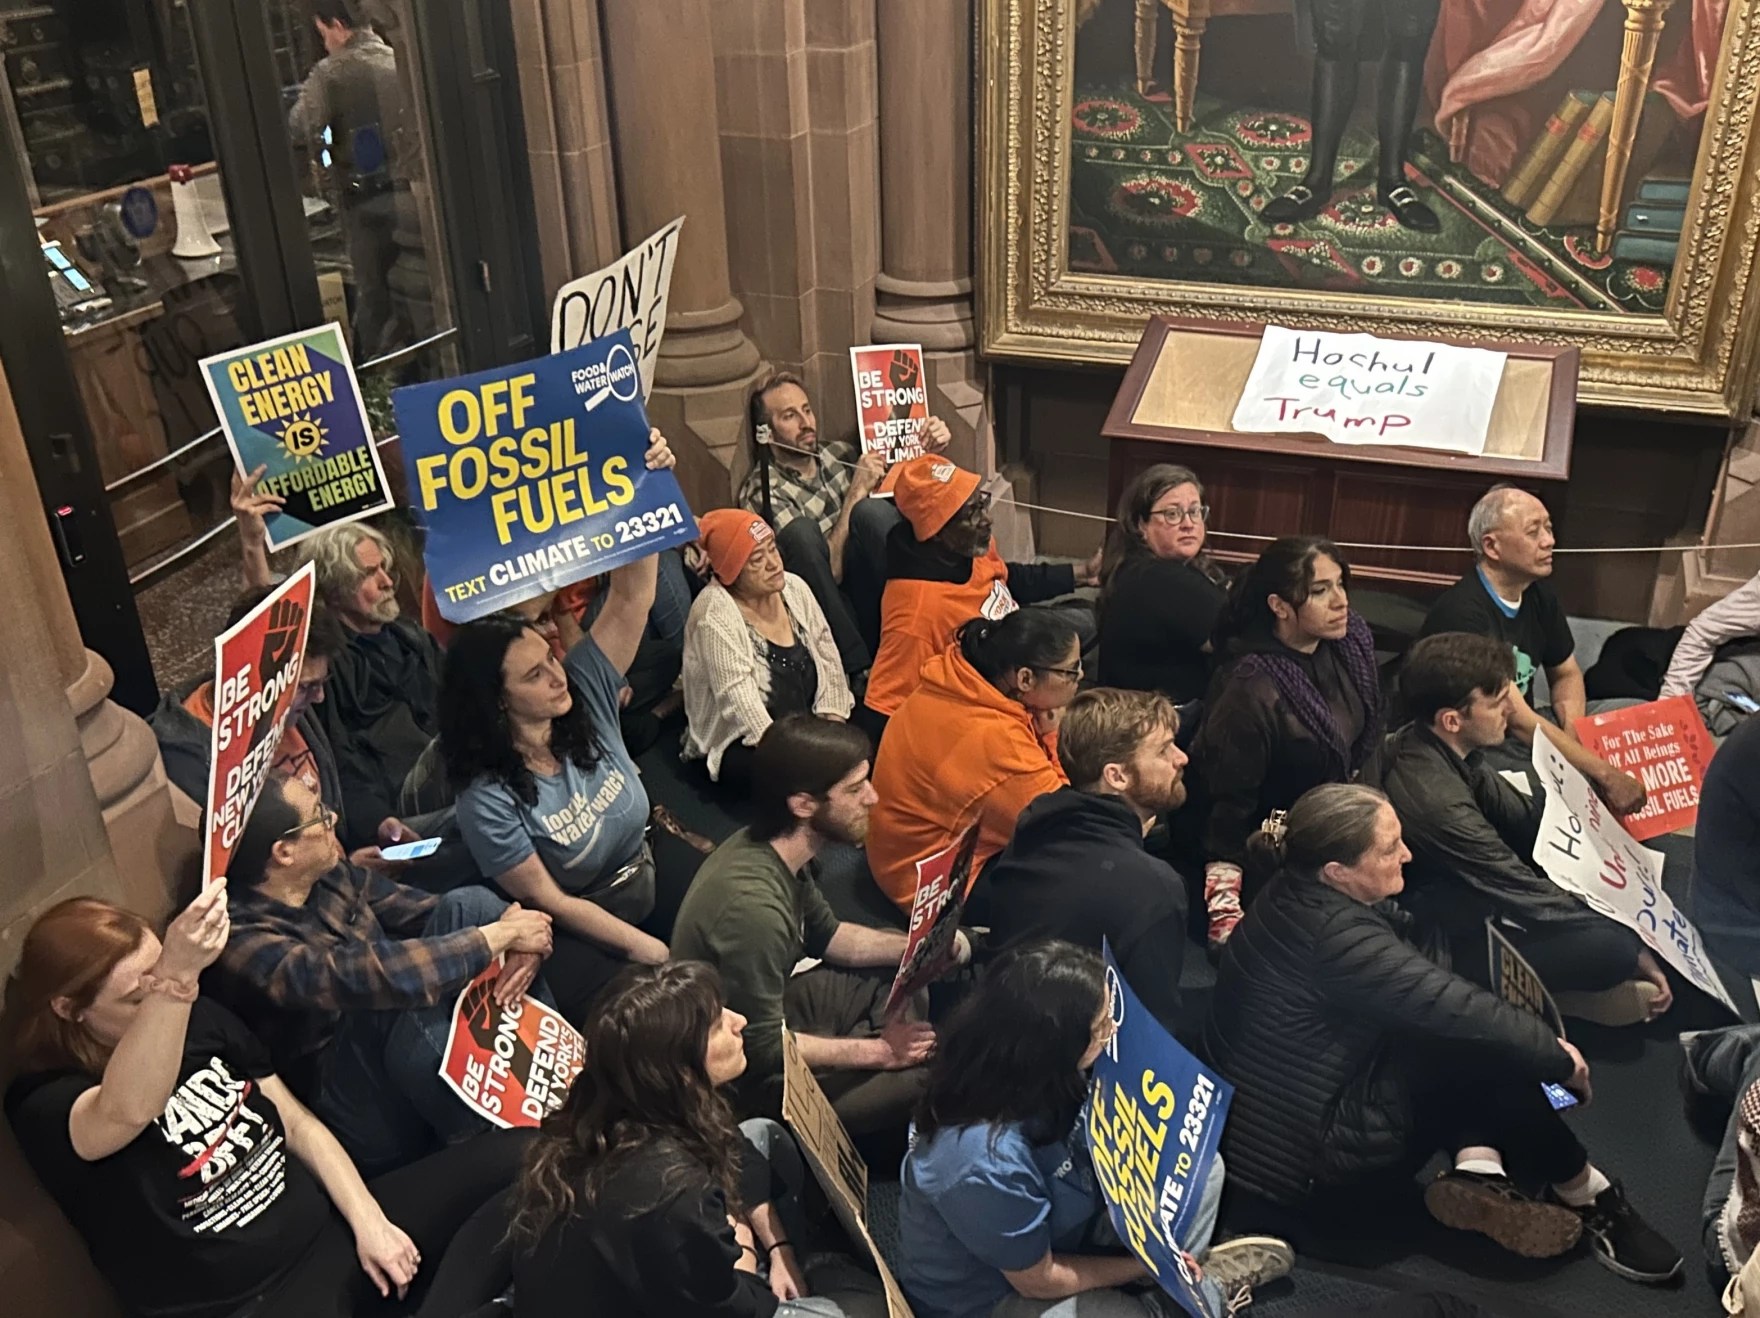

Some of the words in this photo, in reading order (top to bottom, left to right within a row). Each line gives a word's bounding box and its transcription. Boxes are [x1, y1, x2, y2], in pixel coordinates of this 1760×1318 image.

[559, 225, 677, 351] DON'T
[228, 343, 311, 393] CLEAN
[574, 375, 607, 395] WATER
[609, 364, 634, 383] WATCH
[859, 370, 884, 389] BE
[1292, 337, 1435, 375] Hochul
[238, 371, 334, 426] ENERGY
[438, 373, 536, 445] OFF
[861, 387, 924, 408] STRONG
[1299, 373, 1429, 399] equals
[291, 427, 315, 450] IS
[874, 418, 926, 438] DEFEN
[1263, 397, 1412, 436] Trump
[416, 418, 589, 511] FOSSIL
[867, 436, 897, 451] NEW
[257, 446, 371, 497] AFFORDABLE
[308, 470, 377, 512] ENERGY
[491, 455, 635, 545] FUELS
[445, 576, 487, 604] TEXT
[489, 535, 591, 587] CLIMATE
[591, 533, 615, 551] TO
[615, 502, 684, 544] 23321
[218, 651, 300, 751] STRONG
[220, 663, 252, 715] BE
[1601, 736, 1621, 751] For
[1622, 729, 1647, 746] The
[1647, 723, 1675, 740] Sake
[1624, 748, 1641, 766] All
[1643, 742, 1681, 761] Beings
[1640, 757, 1693, 792] MORE
[1663, 785, 1700, 812] FUELS
[212, 783, 251, 833] NEW
[915, 874, 944, 908] BE
[461, 1053, 486, 1101] BE
[480, 999, 524, 1115] STRONG
[521, 1015, 561, 1121] DEFEND
[551, 1026, 574, 1089] YORK'S
[1179, 1073, 1215, 1152] 23321
[1090, 1077, 1121, 1205] OFF
[1134, 1068, 1176, 1248] FUELS
[1174, 1152, 1192, 1179] TO
[1113, 1081, 1160, 1278] FOSSIL
